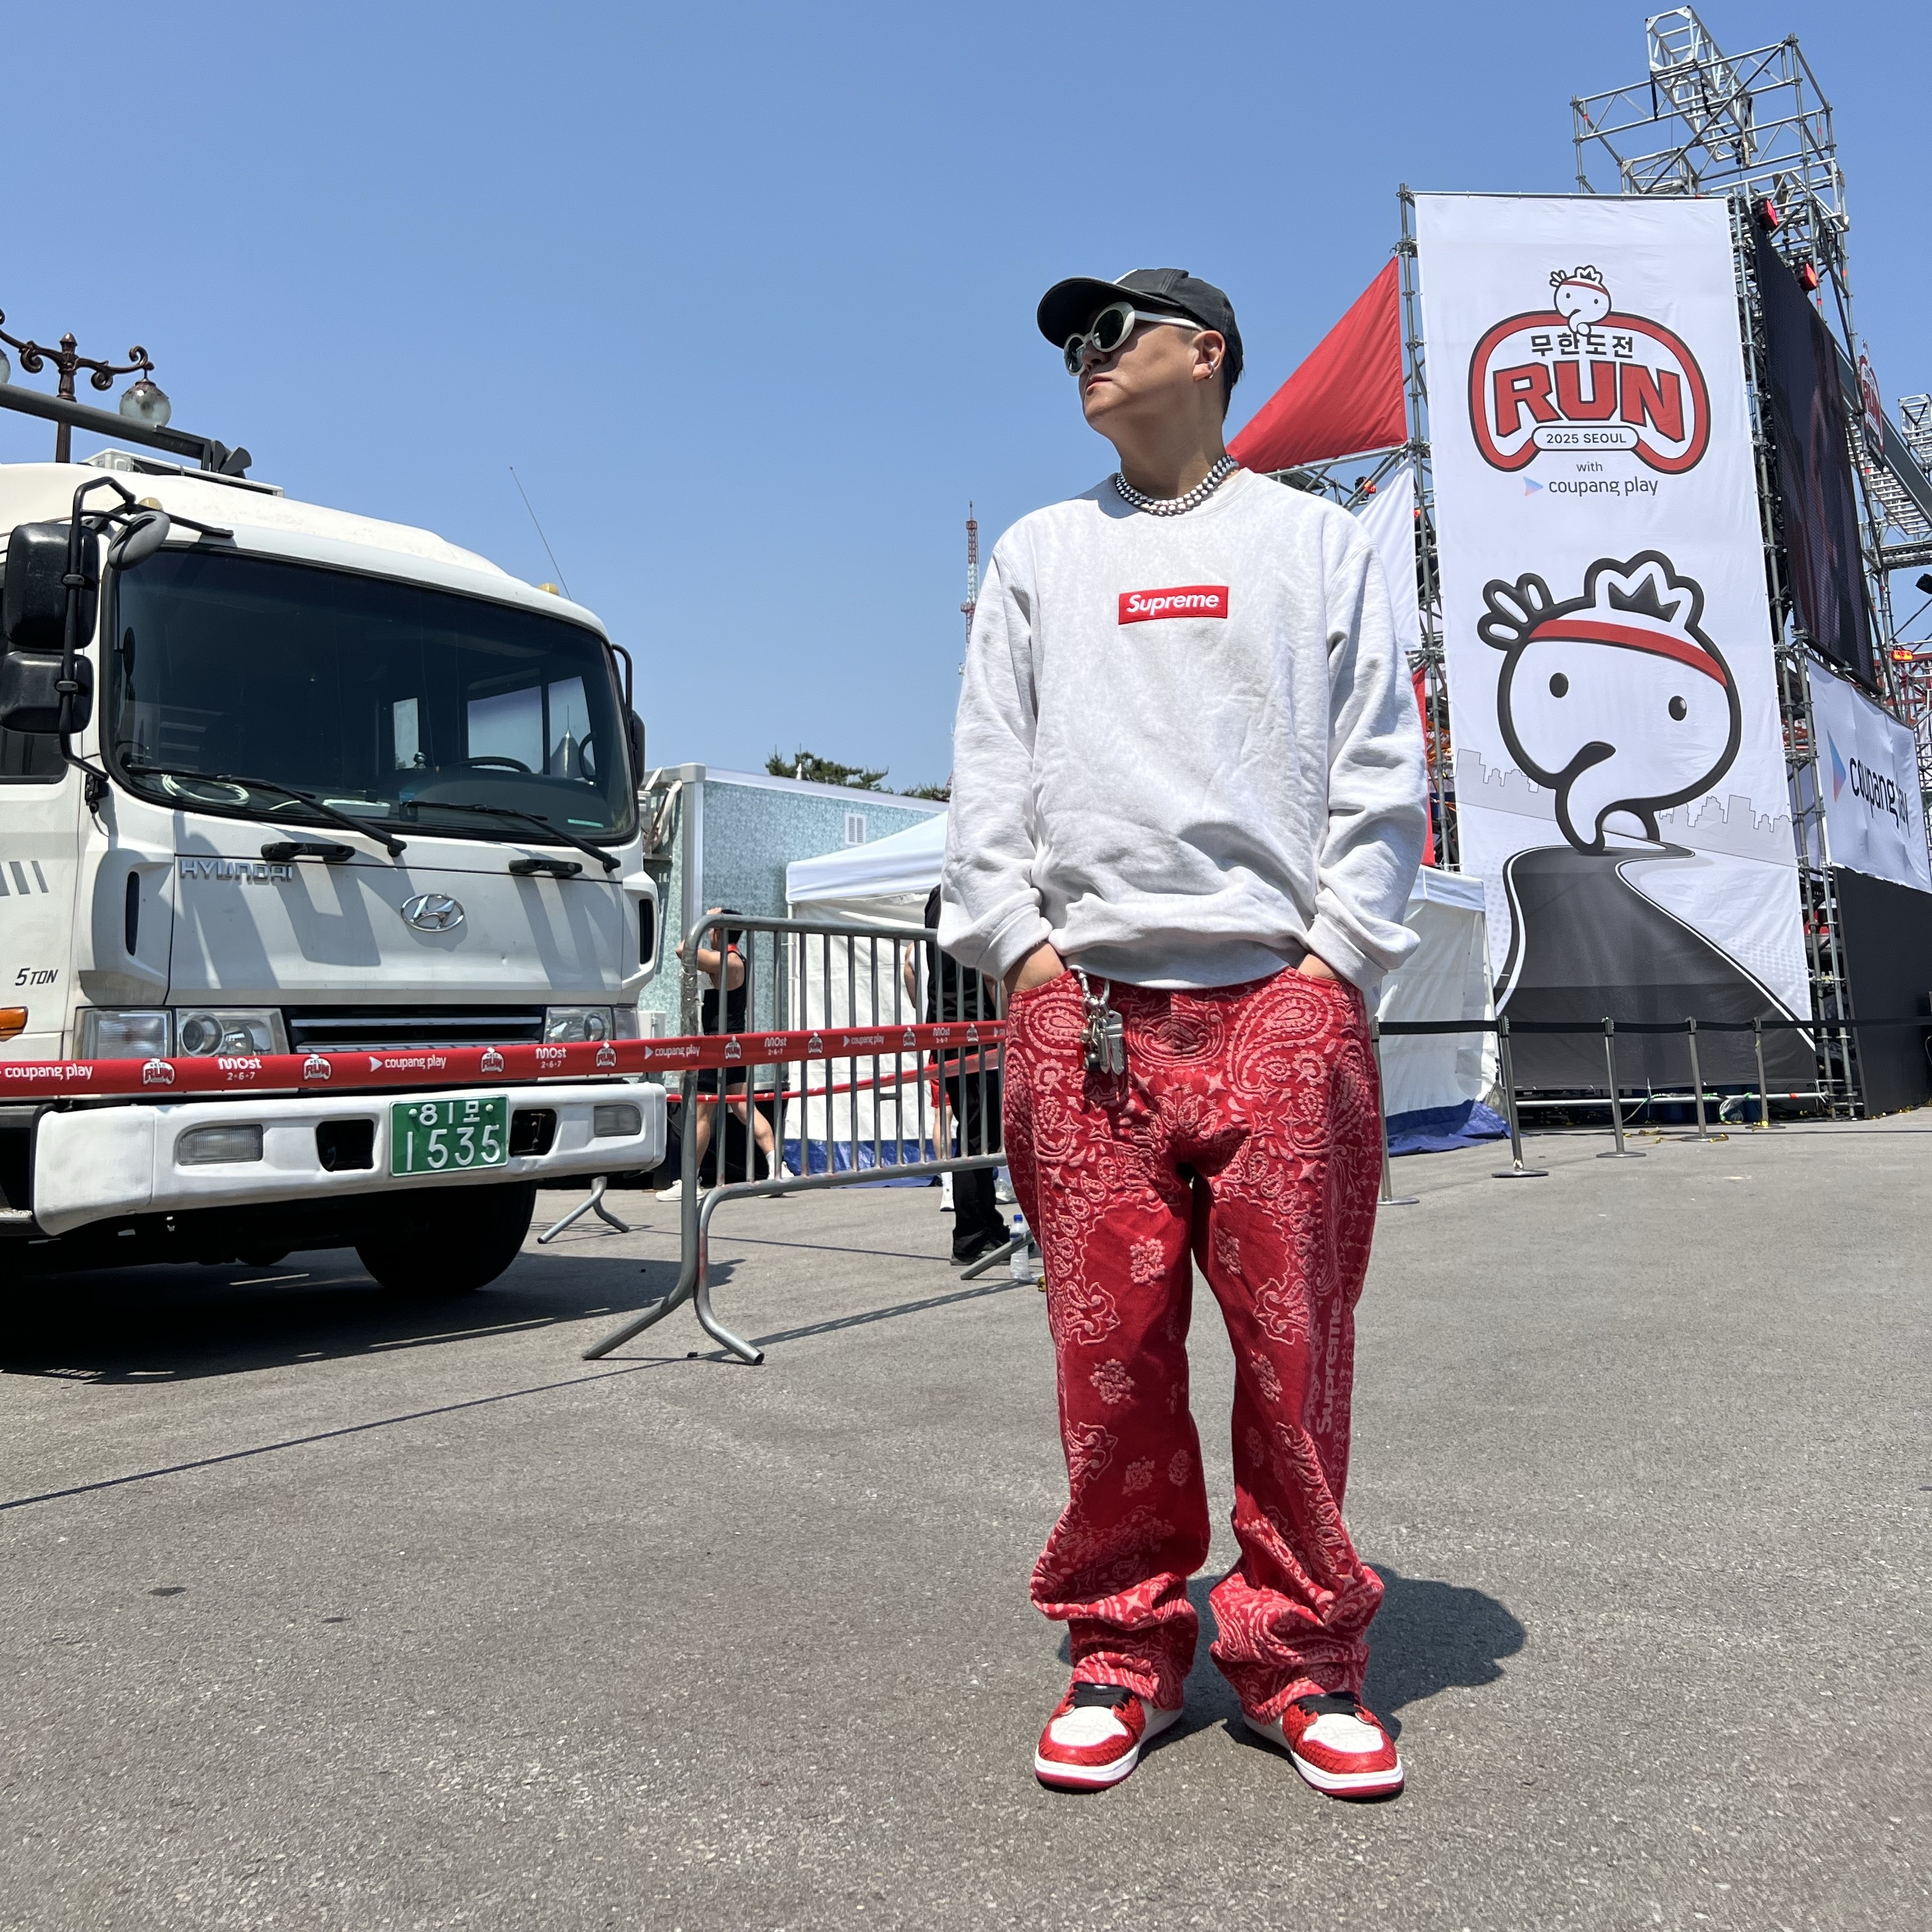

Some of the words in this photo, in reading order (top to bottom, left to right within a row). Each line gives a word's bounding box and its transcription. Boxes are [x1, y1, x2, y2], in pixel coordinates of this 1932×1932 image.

[1531, 332, 1633, 358] 무한도전
[1492, 360, 1685, 443] RUN
[1546, 433, 1579, 444] 2025
[1583, 433, 1627, 443] SEOUL
[1576, 461, 1603, 472] with
[1549, 479, 1620, 496] coupang
[1625, 477, 1659, 496] play
[1126, 594, 1220, 616] Supreme
[180, 859, 293, 882] HYUNDAI
[15, 967, 31, 986] 5
[31, 969, 59, 985] TON
[655, 1048, 685, 1058] coupang
[686, 1044, 701, 1056] play
[4, 1065, 63, 1080] coupang
[66, 1062, 93, 1080] play
[385, 1057, 425, 1071] coupang
[427, 1054, 447, 1070] play
[419, 1100, 480, 1126] 81모
[406, 1124, 500, 1171] 1535
[1316, 1296, 1341, 1435] Supreme
